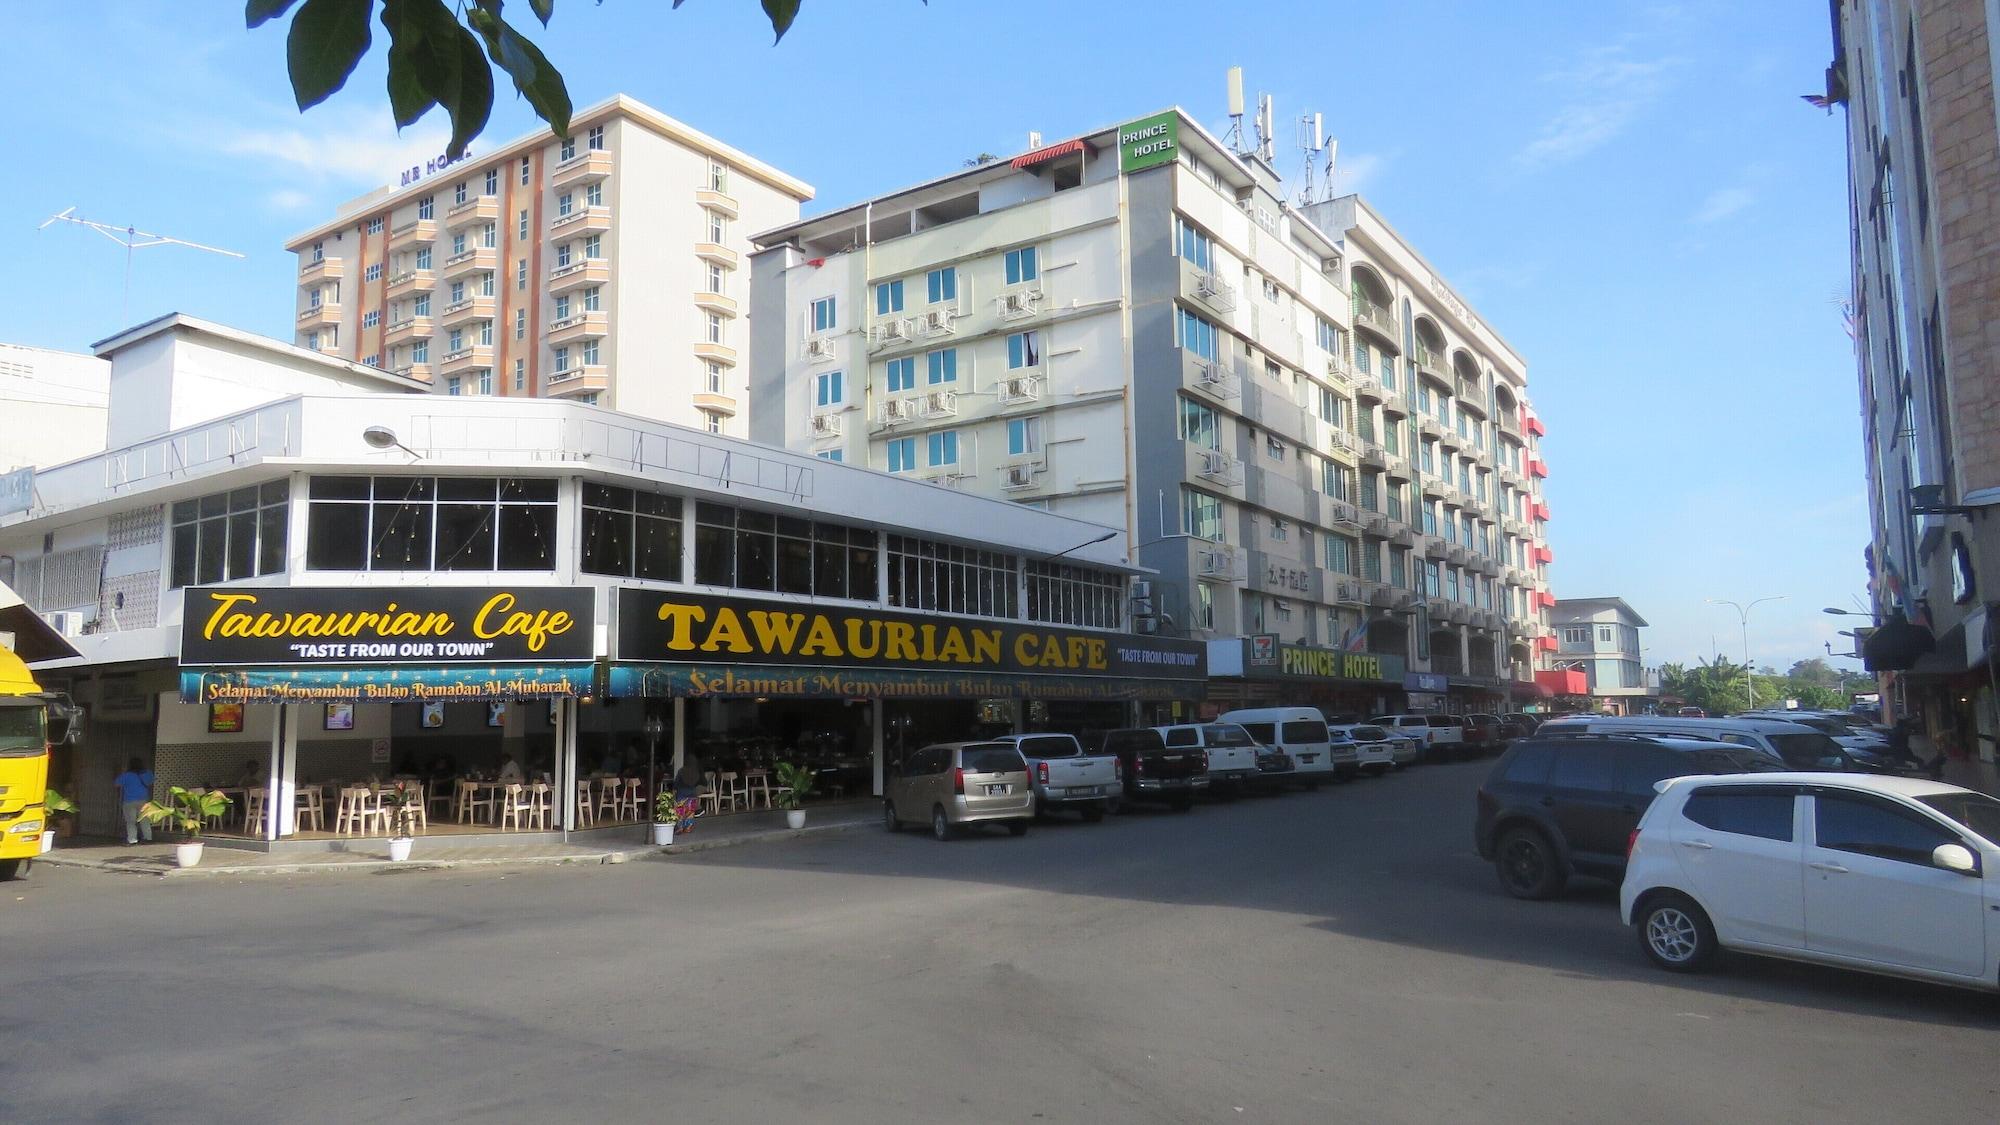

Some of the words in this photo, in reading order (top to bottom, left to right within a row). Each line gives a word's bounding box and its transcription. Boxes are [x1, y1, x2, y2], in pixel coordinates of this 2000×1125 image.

[1122, 123, 1167, 144] PRINCE
[1134, 139, 1174, 157] HOTEL
[204, 593, 455, 640] Tawaurian
[473, 592, 574, 652] Cafe
[657, 602, 1001, 664] TAWAURIAN
[1013, 632, 1108, 670] CAFE
[350, 642, 397, 657] FROM
[400, 642, 434, 657] OUR
[1142, 650, 1162, 664] FROM
[1162, 652, 1176, 665] OUR
[1282, 647, 1337, 677] PRINCE
[1344, 654, 1383, 679] HOTEL
[208, 683, 269, 701] Selamat
[271, 682, 361, 701] Menyambut
[363, 683, 408, 699] Bulan
[412, 681, 481, 699] Ramadan
[481, 678, 579, 697] Al-Mubarak
[688, 668, 807, 696] Selamat
[811, 672, 951, 698] Menyambut
[955, 678, 1013, 698] Bulan
[1017, 679, 1091, 699] Ramadan
